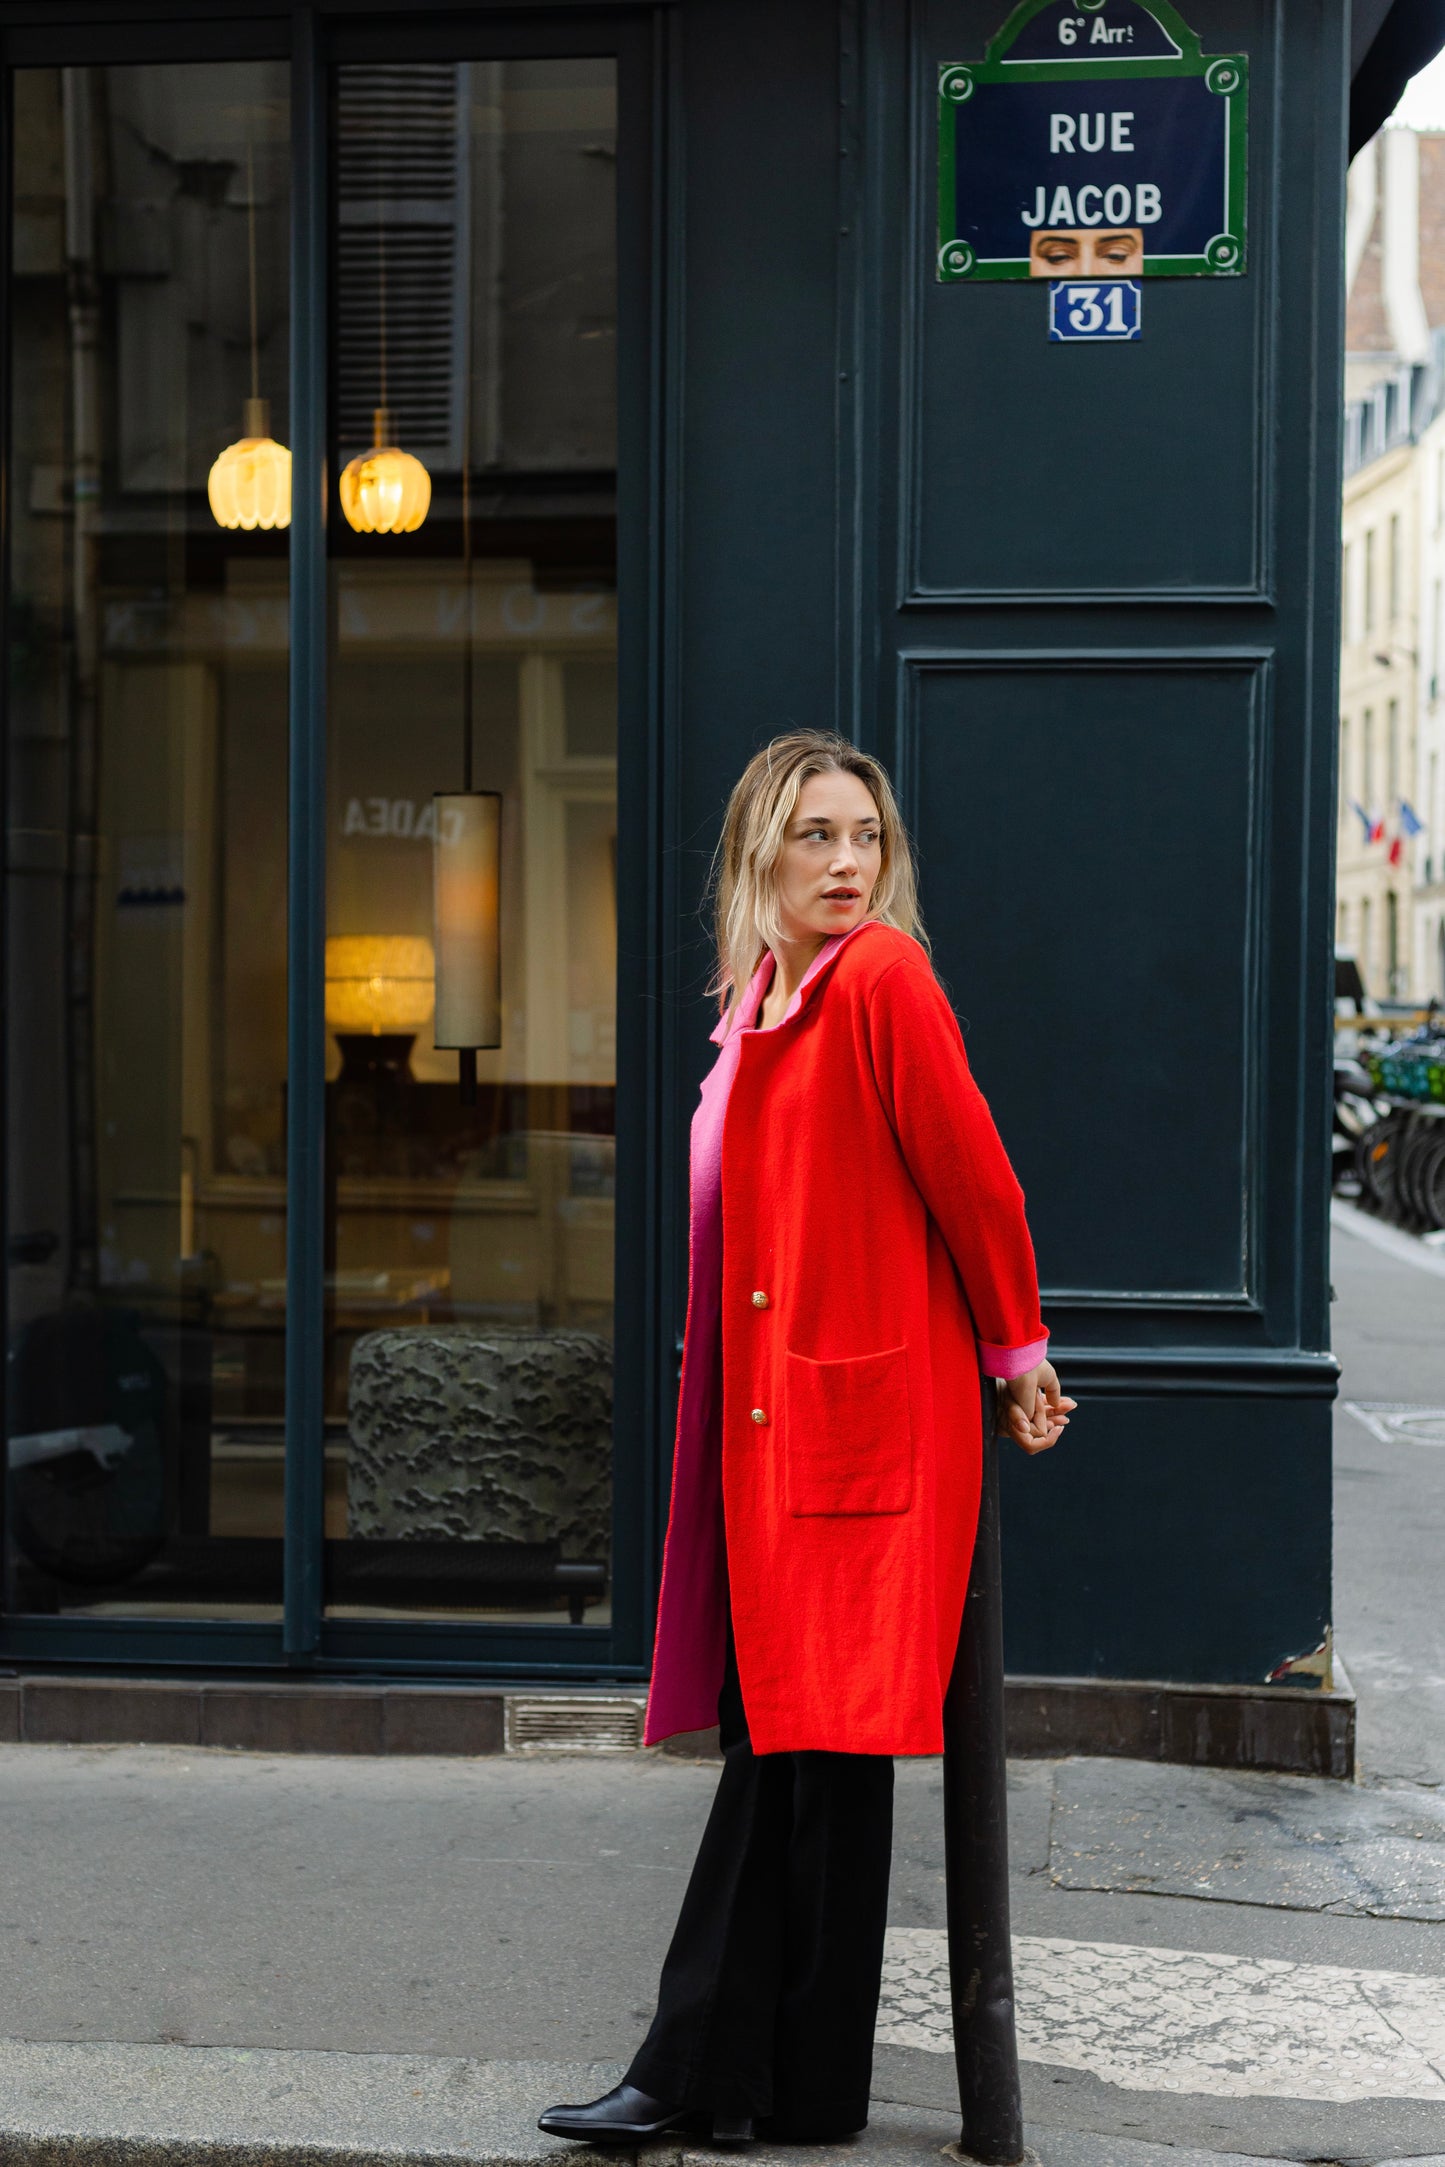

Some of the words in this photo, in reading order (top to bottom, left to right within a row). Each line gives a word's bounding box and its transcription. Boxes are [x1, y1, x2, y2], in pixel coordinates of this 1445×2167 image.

[1050, 111, 1135, 153] RUE
[1021, 183, 1163, 227] JACOB
[1067, 286, 1129, 332] 31
